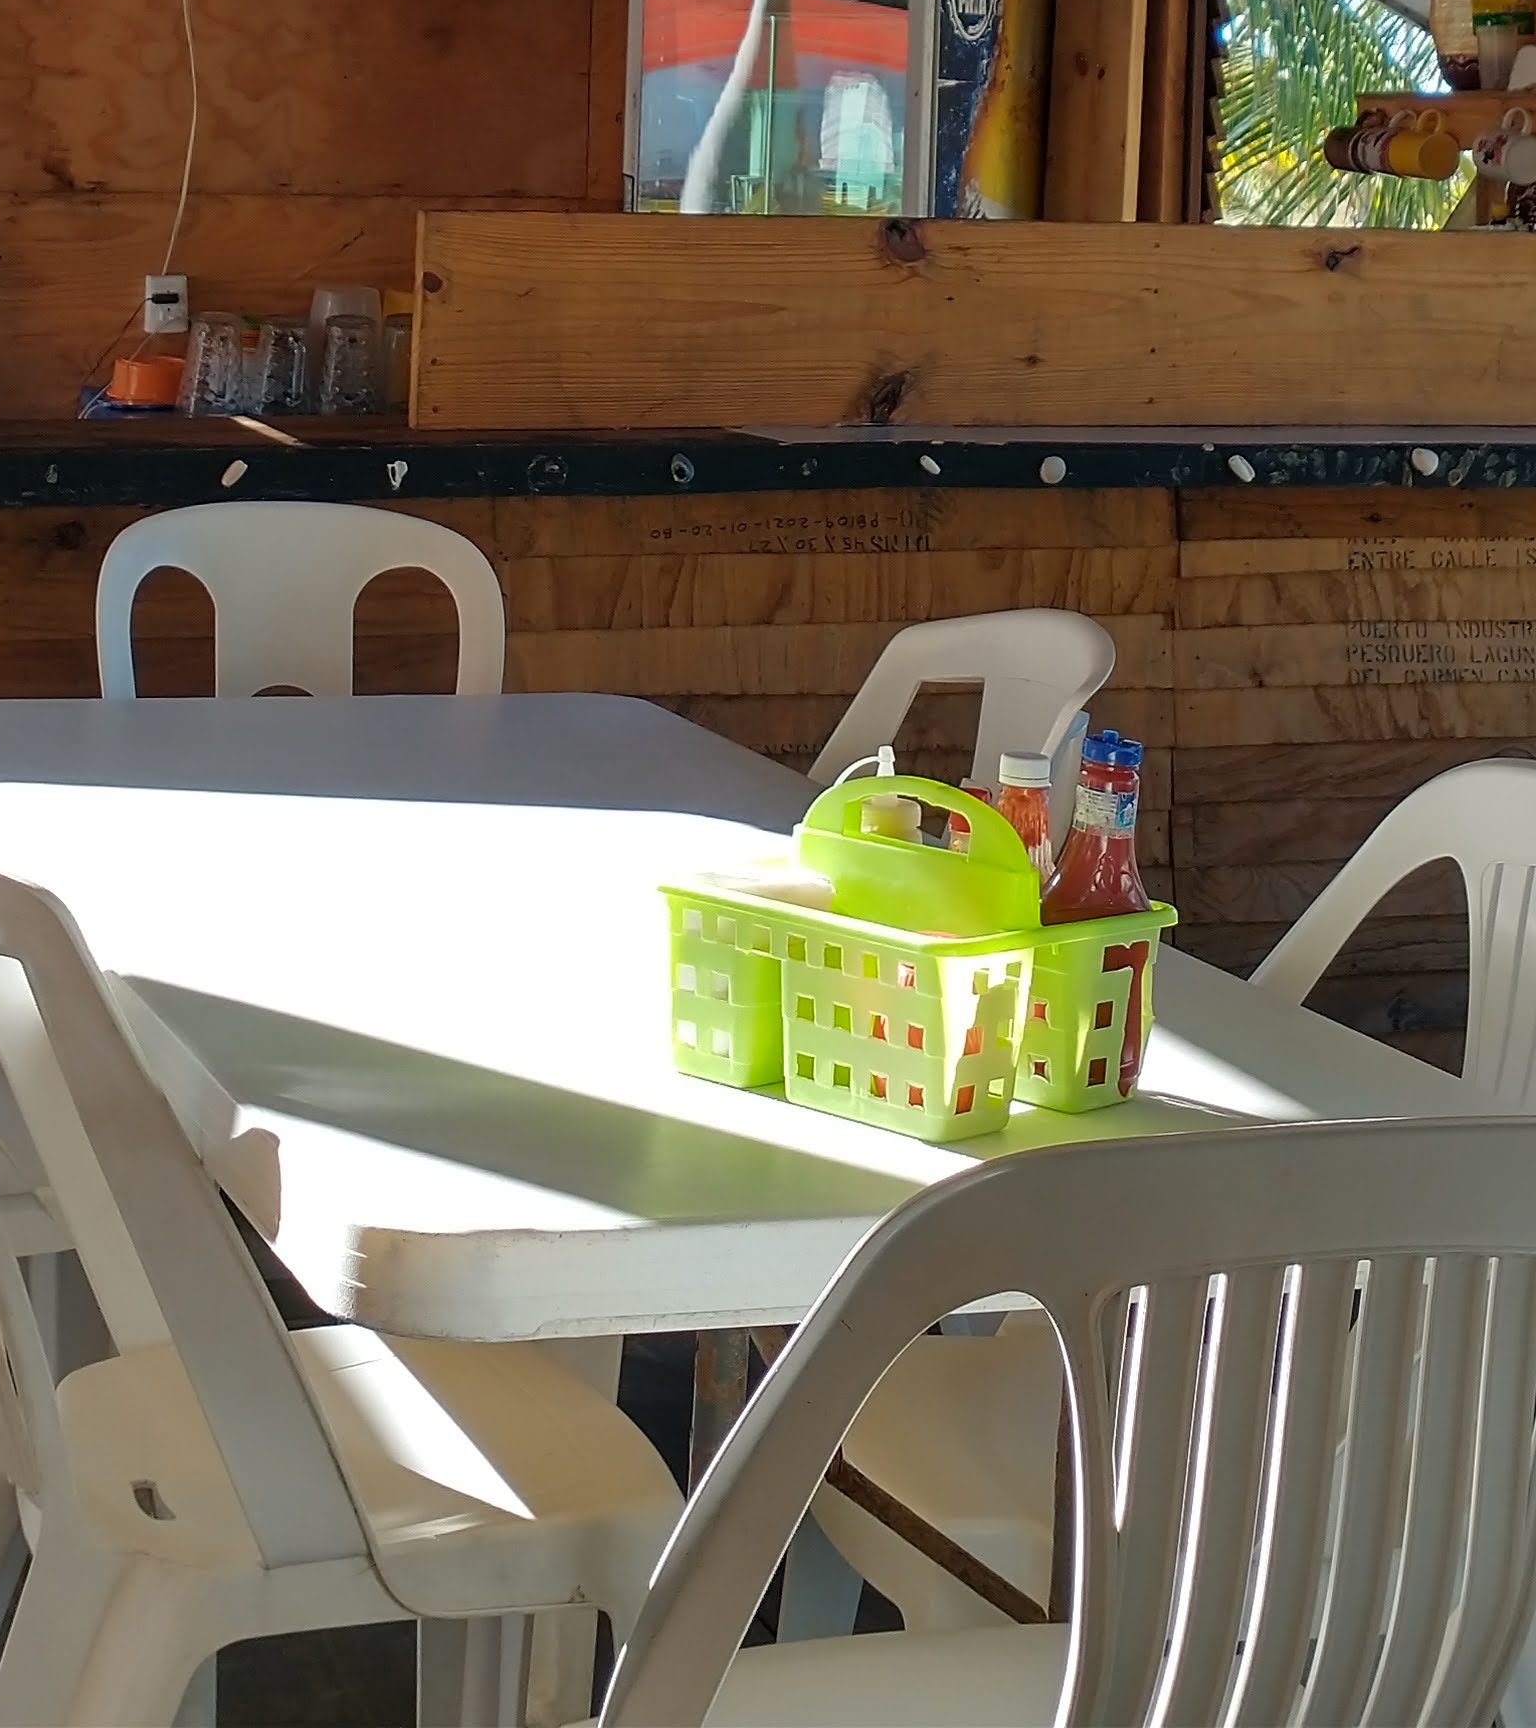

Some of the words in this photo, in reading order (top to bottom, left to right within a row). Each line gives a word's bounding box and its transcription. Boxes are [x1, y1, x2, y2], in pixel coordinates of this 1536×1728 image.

[1347, 549, 1415, 570] ENTRE
[1430, 548, 1497, 568] CALLE
[1345, 622, 1428, 639] PUERTO
[1345, 644, 1456, 664] PESQUERO
[1346, 668, 1383, 685] DEL
[1403, 667, 1484, 684] CARMEN
